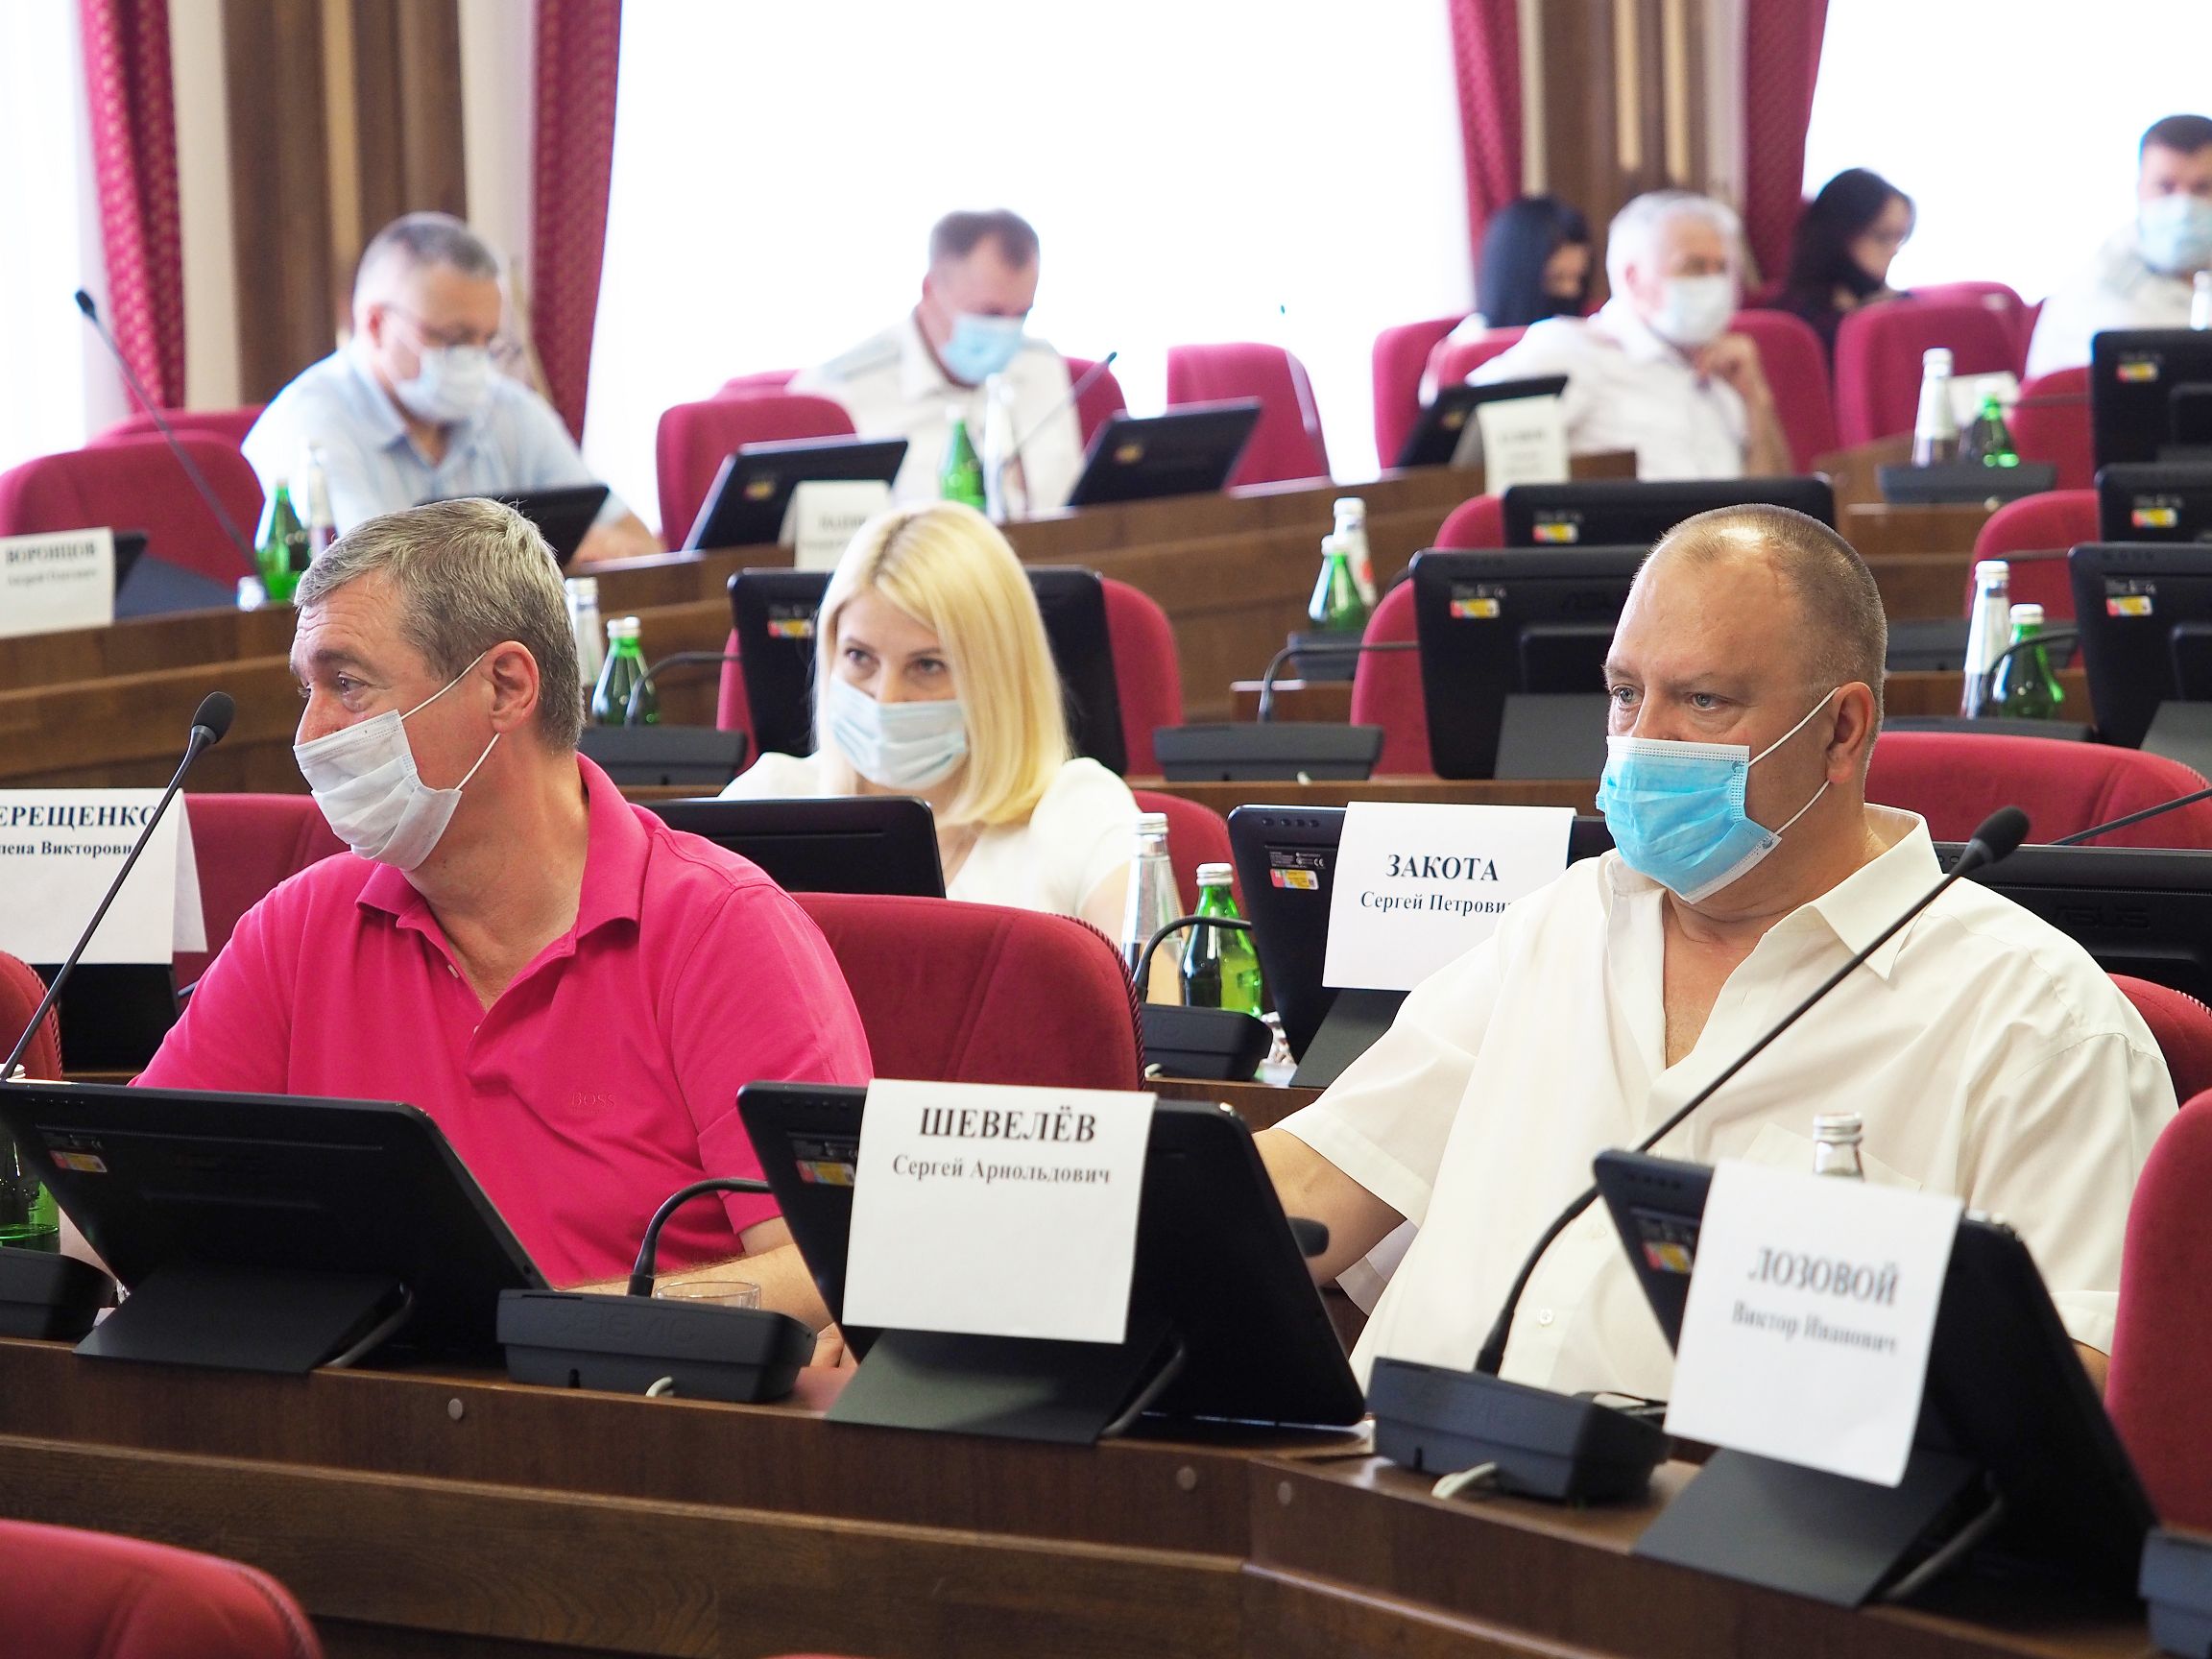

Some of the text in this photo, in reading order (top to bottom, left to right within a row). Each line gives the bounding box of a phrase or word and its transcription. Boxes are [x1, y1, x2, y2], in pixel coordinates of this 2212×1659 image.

[1385, 854, 1500, 882] ЗАКОТА
[1360, 890, 1511, 916] Сергей Петрови
[571, 1092, 616, 1106] BOSS
[919, 1105, 1096, 1142] ШЕВЕЛЁВ
[892, 1154, 1111, 1184] Сергей Арнольдович
[1748, 1247, 1899, 1306] ЛОЗОВОЙ
